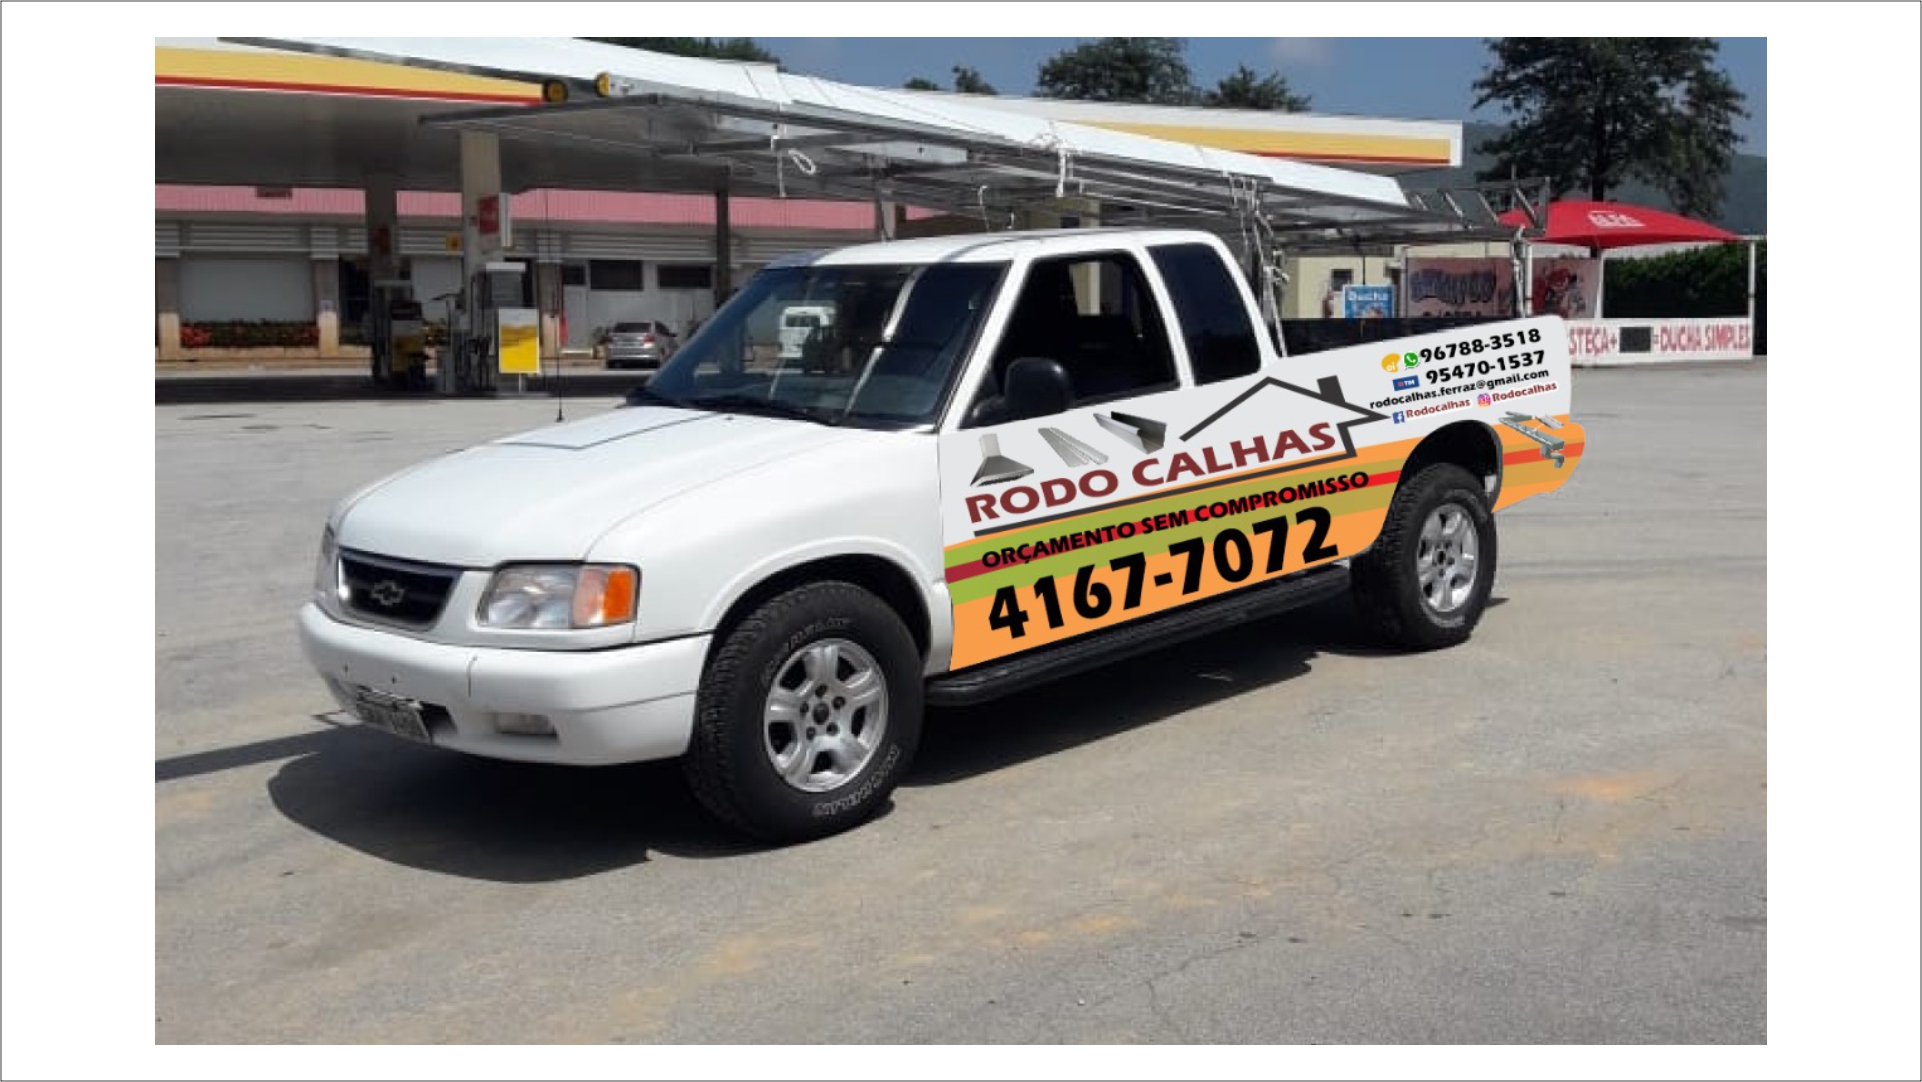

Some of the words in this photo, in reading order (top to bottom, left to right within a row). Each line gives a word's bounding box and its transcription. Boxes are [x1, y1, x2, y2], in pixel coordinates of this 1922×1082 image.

[1420, 328, 1541, 363] 96788-3518
[1426, 350, 1545, 384] 95470-1537
[1369, 368, 1549, 409] rodocalhas.ferraz@gmail.com
[1406, 398, 1470, 418] Rodocalhas
[1492, 381, 1557, 402] Rodocalhas
[965, 469, 1119, 523] RODO
[1131, 422, 1336, 487] CALHAS
[981, 521, 1136, 564] ORÇAMENTO
[1141, 508, 1189, 533] SEM
[1194, 471, 1369, 523] COMPROMISSO
[988, 506, 1338, 639] 4167-7072
